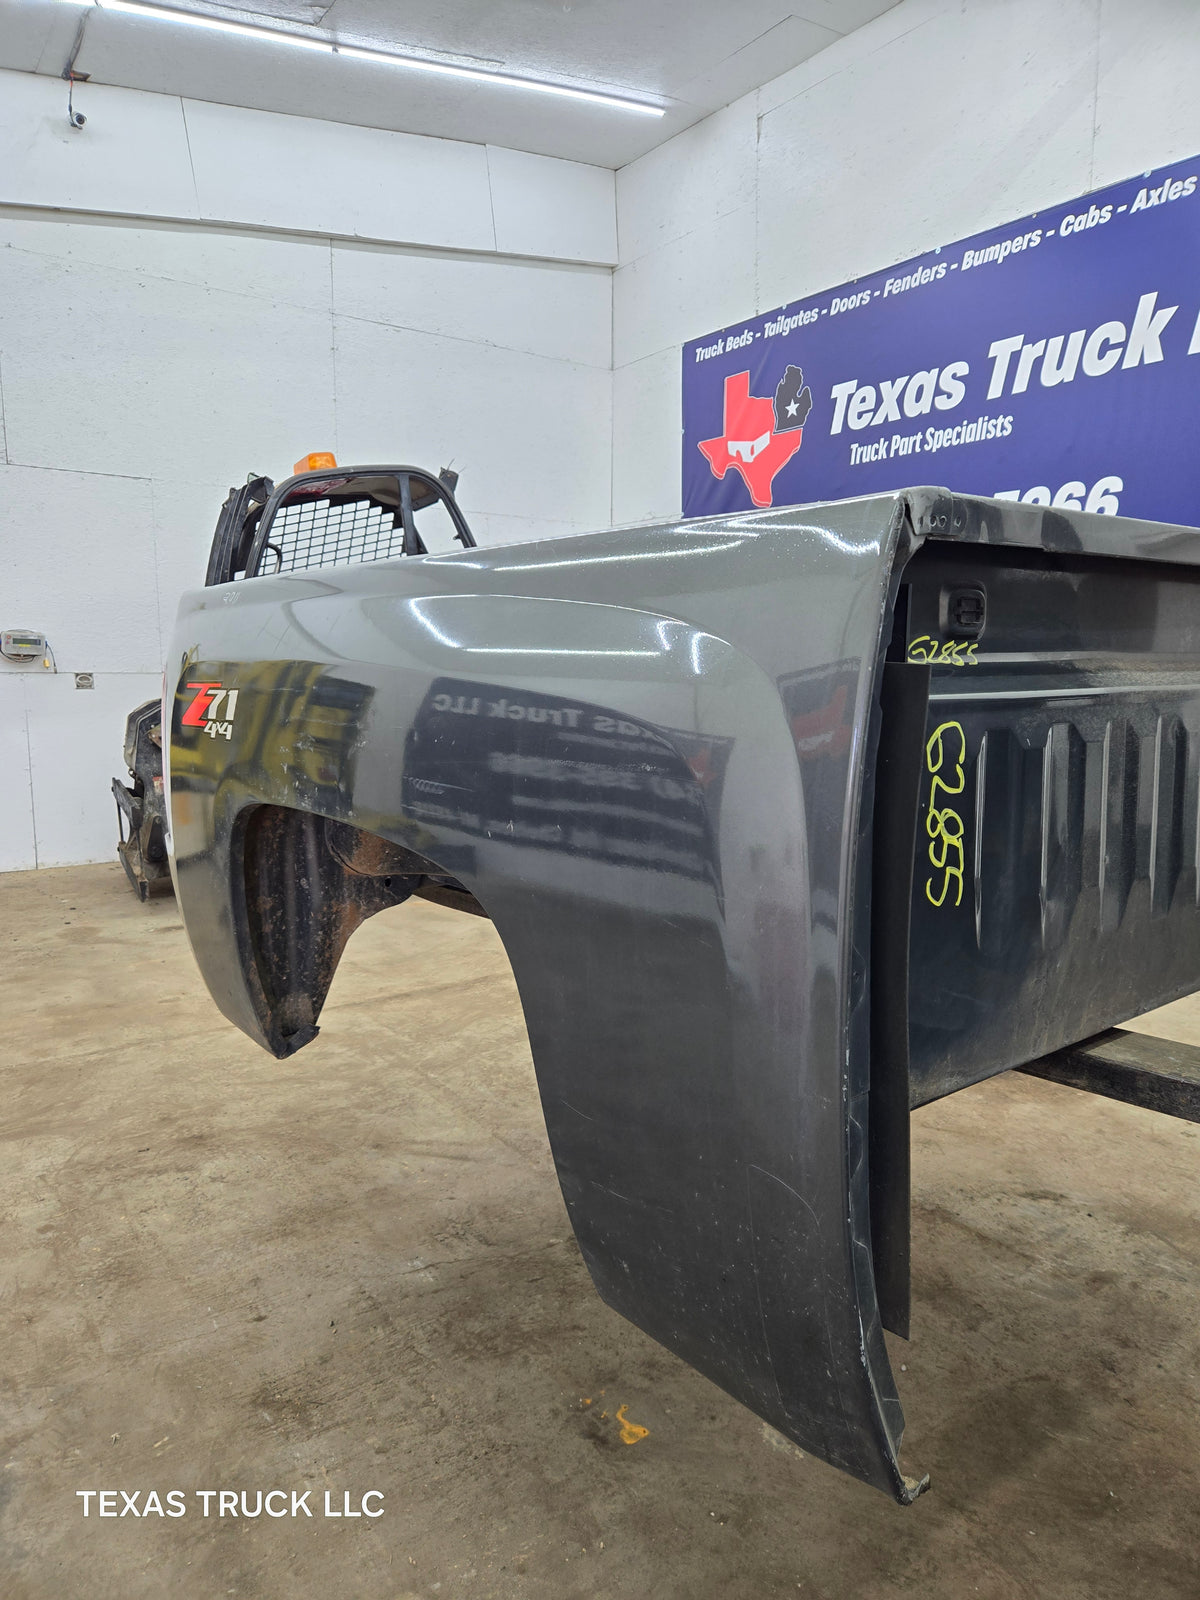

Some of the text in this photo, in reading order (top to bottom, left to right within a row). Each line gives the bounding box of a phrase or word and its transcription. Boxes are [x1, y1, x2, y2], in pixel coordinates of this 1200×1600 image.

[695, 338, 724, 363] Truck
[725, 329, 754, 353] Beds
[763, 307, 819, 339] Tailgates
[829, 290, 871, 317] Doors
[883, 263, 947, 298] Fenders
[961, 229, 1042, 271] Bumpers
[1059, 204, 1113, 237] Cabs
[1129, 175, 1198, 215] Axles
[830, 361, 969, 436] Texas
[986, 291, 1179, 401] Truck
[850, 414, 1014, 466] Truck Part Specialists
[181, 682, 239, 727] Z71
